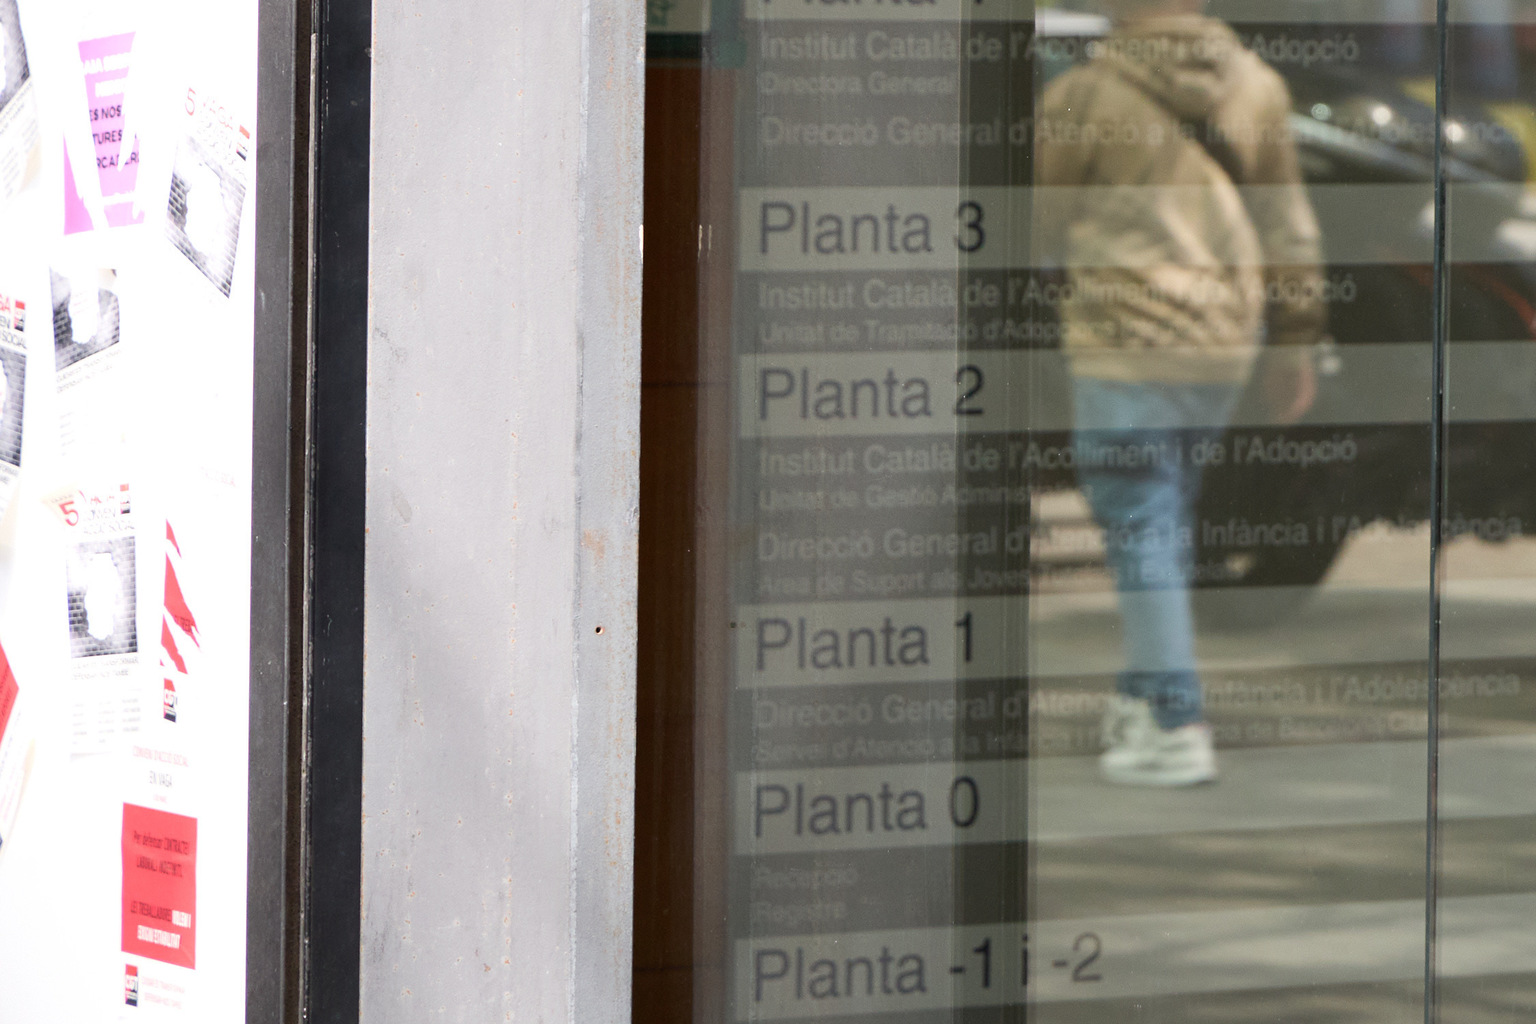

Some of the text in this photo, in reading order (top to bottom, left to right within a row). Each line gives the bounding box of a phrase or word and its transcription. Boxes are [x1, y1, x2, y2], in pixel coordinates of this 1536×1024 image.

[761, 31, 857, 61] Institut
[865, 29, 961, 62] Català
[966, 29, 1003, 61] de
[101, 104, 122, 119] NOS
[760, 115, 879, 147] Direcció
[886, 115, 1001, 147] General
[761, 199, 986, 255] Planta 3
[758, 281, 855, 310] Institut
[862, 278, 957, 310] Català
[963, 278, 1001, 308] de
[760, 364, 984, 419] Planta 2
[758, 447, 855, 476] Institut
[863, 443, 956, 475] Català
[962, 442, 1001, 472] de
[1007, 438, 1169, 472] l'Acolliment
[1190, 437, 1226, 467] de
[1233, 433, 1359, 467] l'Adopció
[59, 500, 79, 527] 5
[757, 530, 875, 561] Direcció
[883, 526, 998, 558] General
[1202, 517, 1309, 547] Infància
[757, 611, 972, 670] Planta 1
[753, 693, 873, 729] Direcció
[880, 682, 996, 724] General
[1201, 676, 1307, 708] Infància
[754, 775, 980, 839] Planta 0
[754, 931, 1104, 1003] Planta -1 i -2
